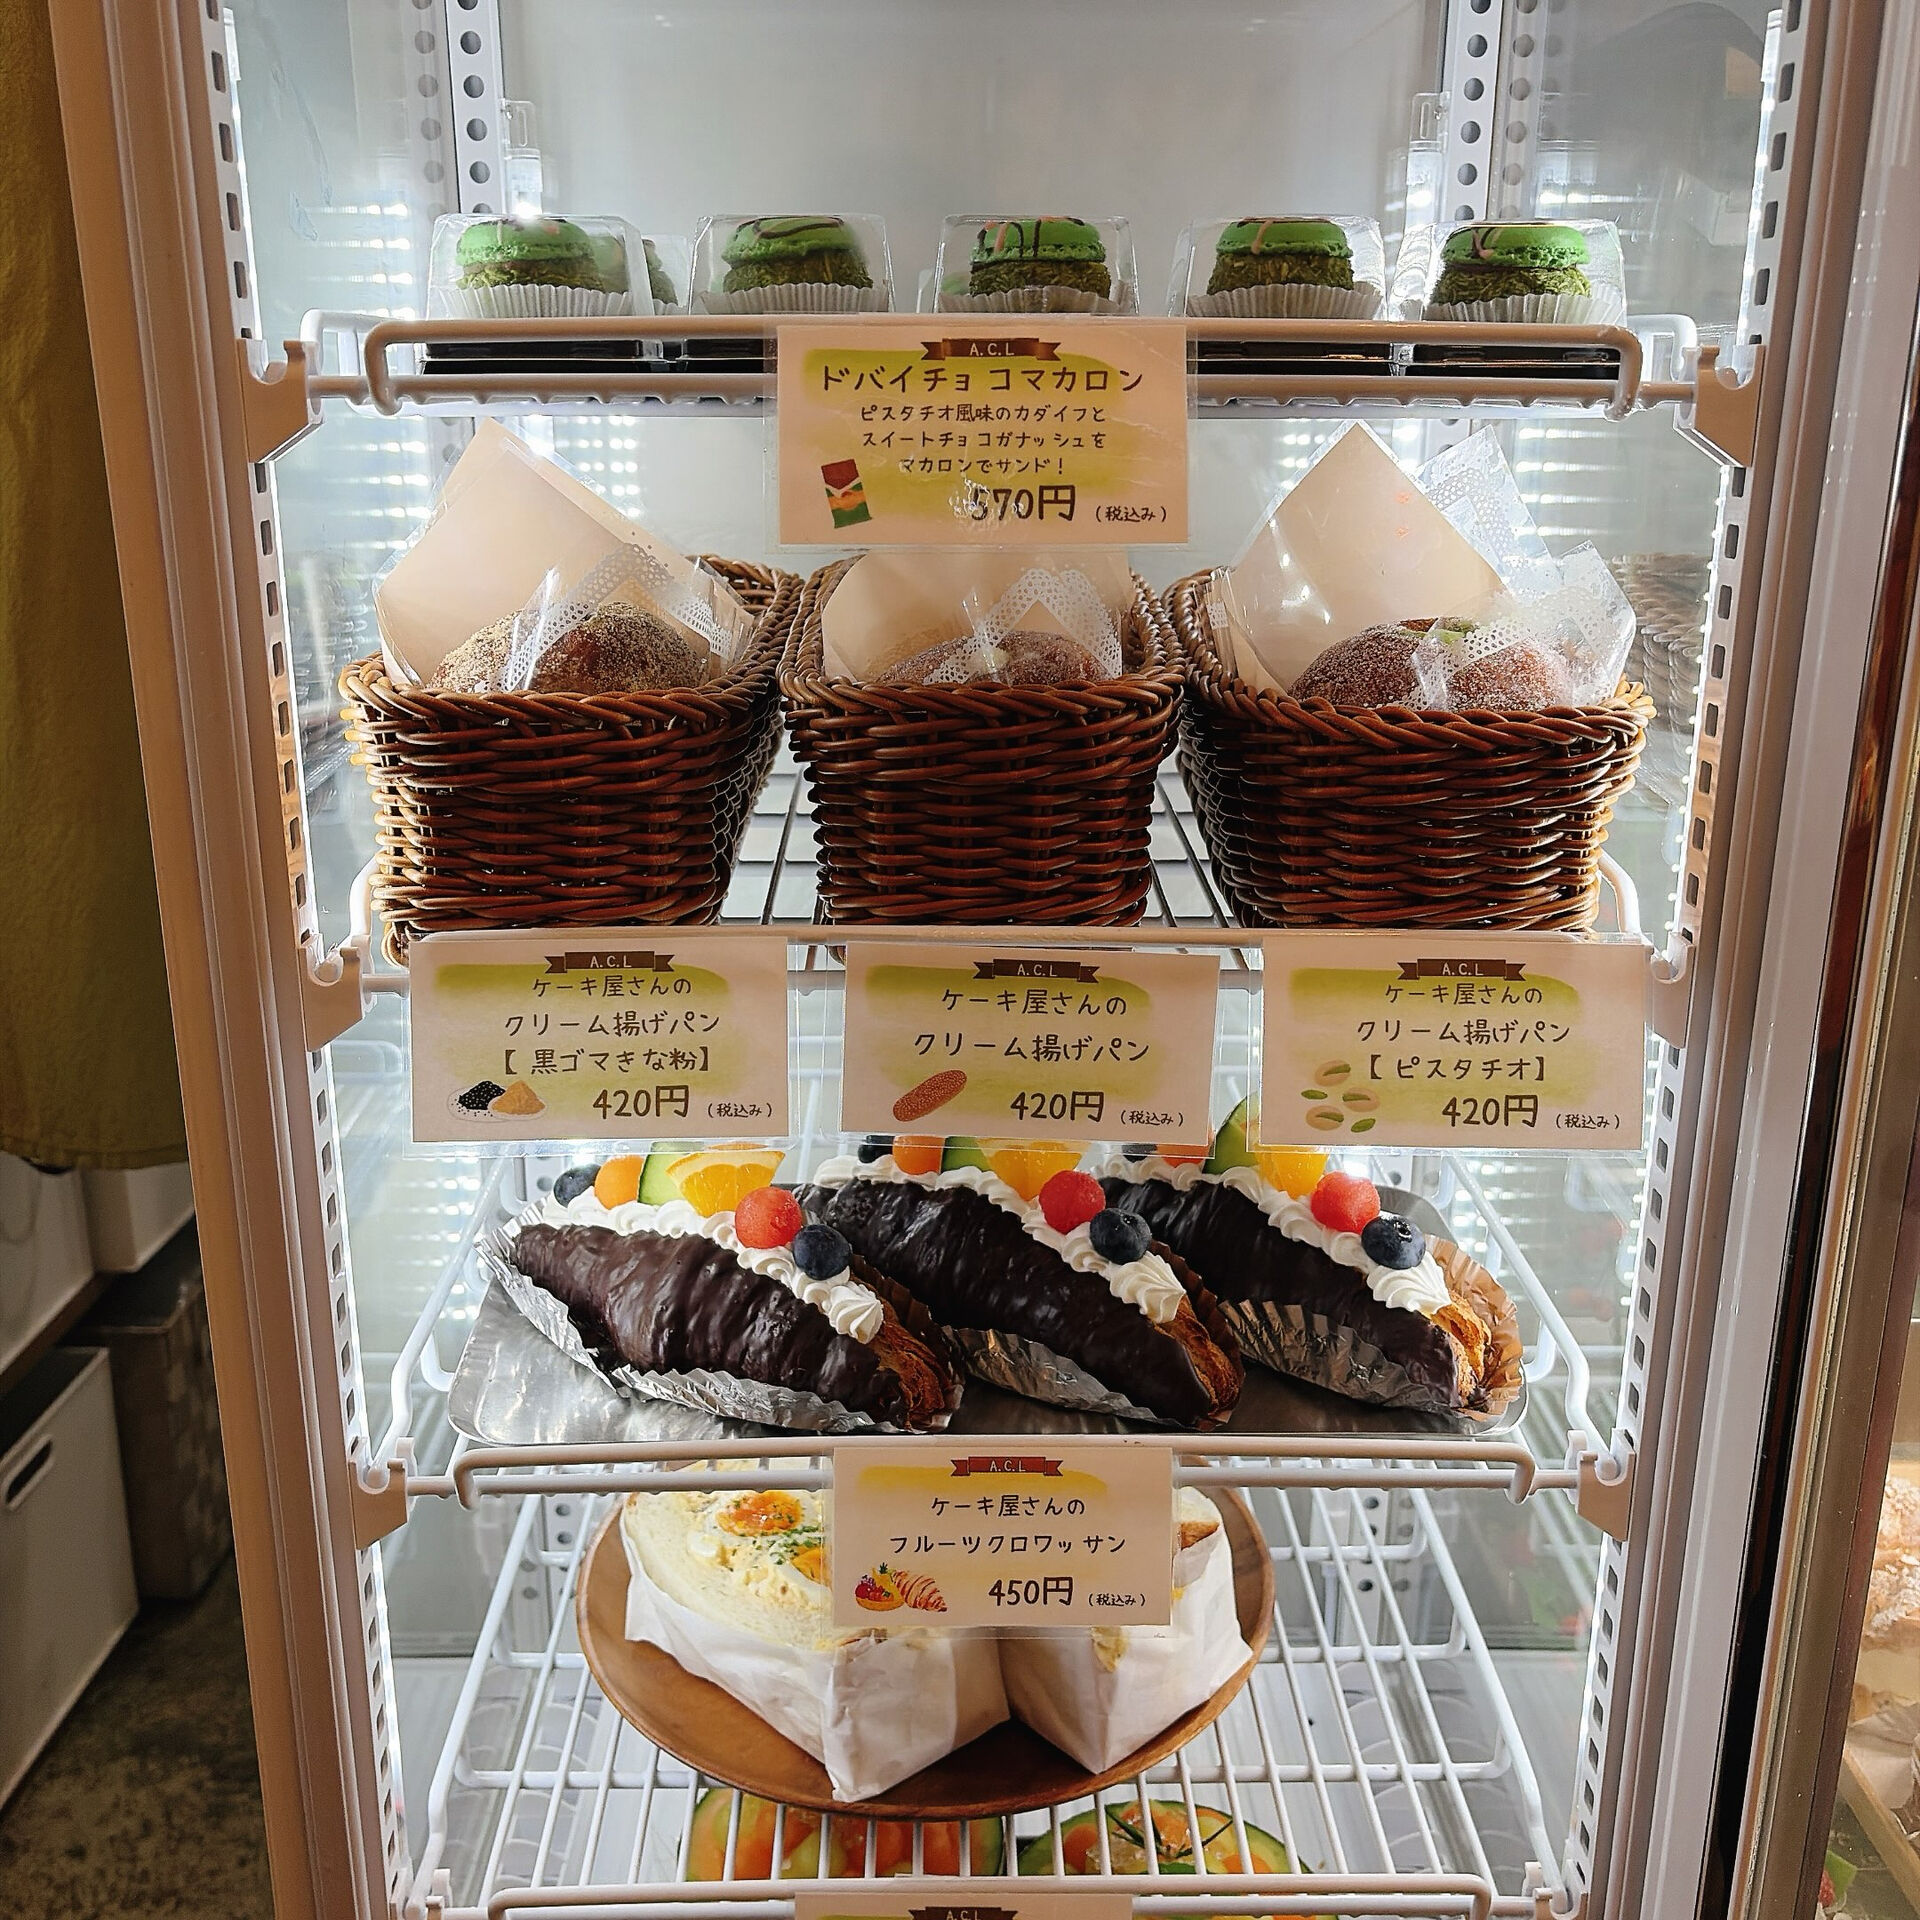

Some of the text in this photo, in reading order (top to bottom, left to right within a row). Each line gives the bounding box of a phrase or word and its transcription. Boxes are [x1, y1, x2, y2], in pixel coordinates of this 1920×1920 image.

[969, 342, 1015, 357] A.C.L
[822, 364, 1144, 393] ドバイチョコマカロン
[861, 403, 1108, 423] ピスタチオ風味のカダイフと
[862, 431, 1106, 449] スイートチョコガナッシュを
[899, 457, 1065, 475] マカロンでサンド!
[968, 484, 1168, 523] 570円 (税込み)
[590, 955, 632, 969] A.C.L
[1017, 963, 1058, 978] A.C.L
[1442, 962, 1485, 977] A.C.L
[532, 974, 692, 998] ケーキ屋さんの
[1384, 983, 1543, 1006] ケーキ屋さんの
[941, 989, 1127, 1016] ケーキ屋さんの
[504, 1010, 720, 1037] クリーム揚げパン
[1357, 1018, 1570, 1045] クリーム揚げパン
[914, 1032, 1150, 1062] クリーム揚げパン
[504, 1046, 709, 1075] 【黒ゴマきな粉】
[1370, 1055, 1545, 1082] 【ピスタチオ】
[592, 1084, 773, 1120] 420円 (税込み)
[1010, 1090, 1184, 1127] 420円 (税込み)
[1441, 1094, 1621, 1130] 420円 (税込み)
[989, 1459, 1027, 1473] A.C.L
[931, 1494, 1086, 1517] ケーキ屋さんの
[889, 1534, 1127, 1555] フルーツクロワッサン
[988, 1575, 1146, 1607] 450円 (税込み)
